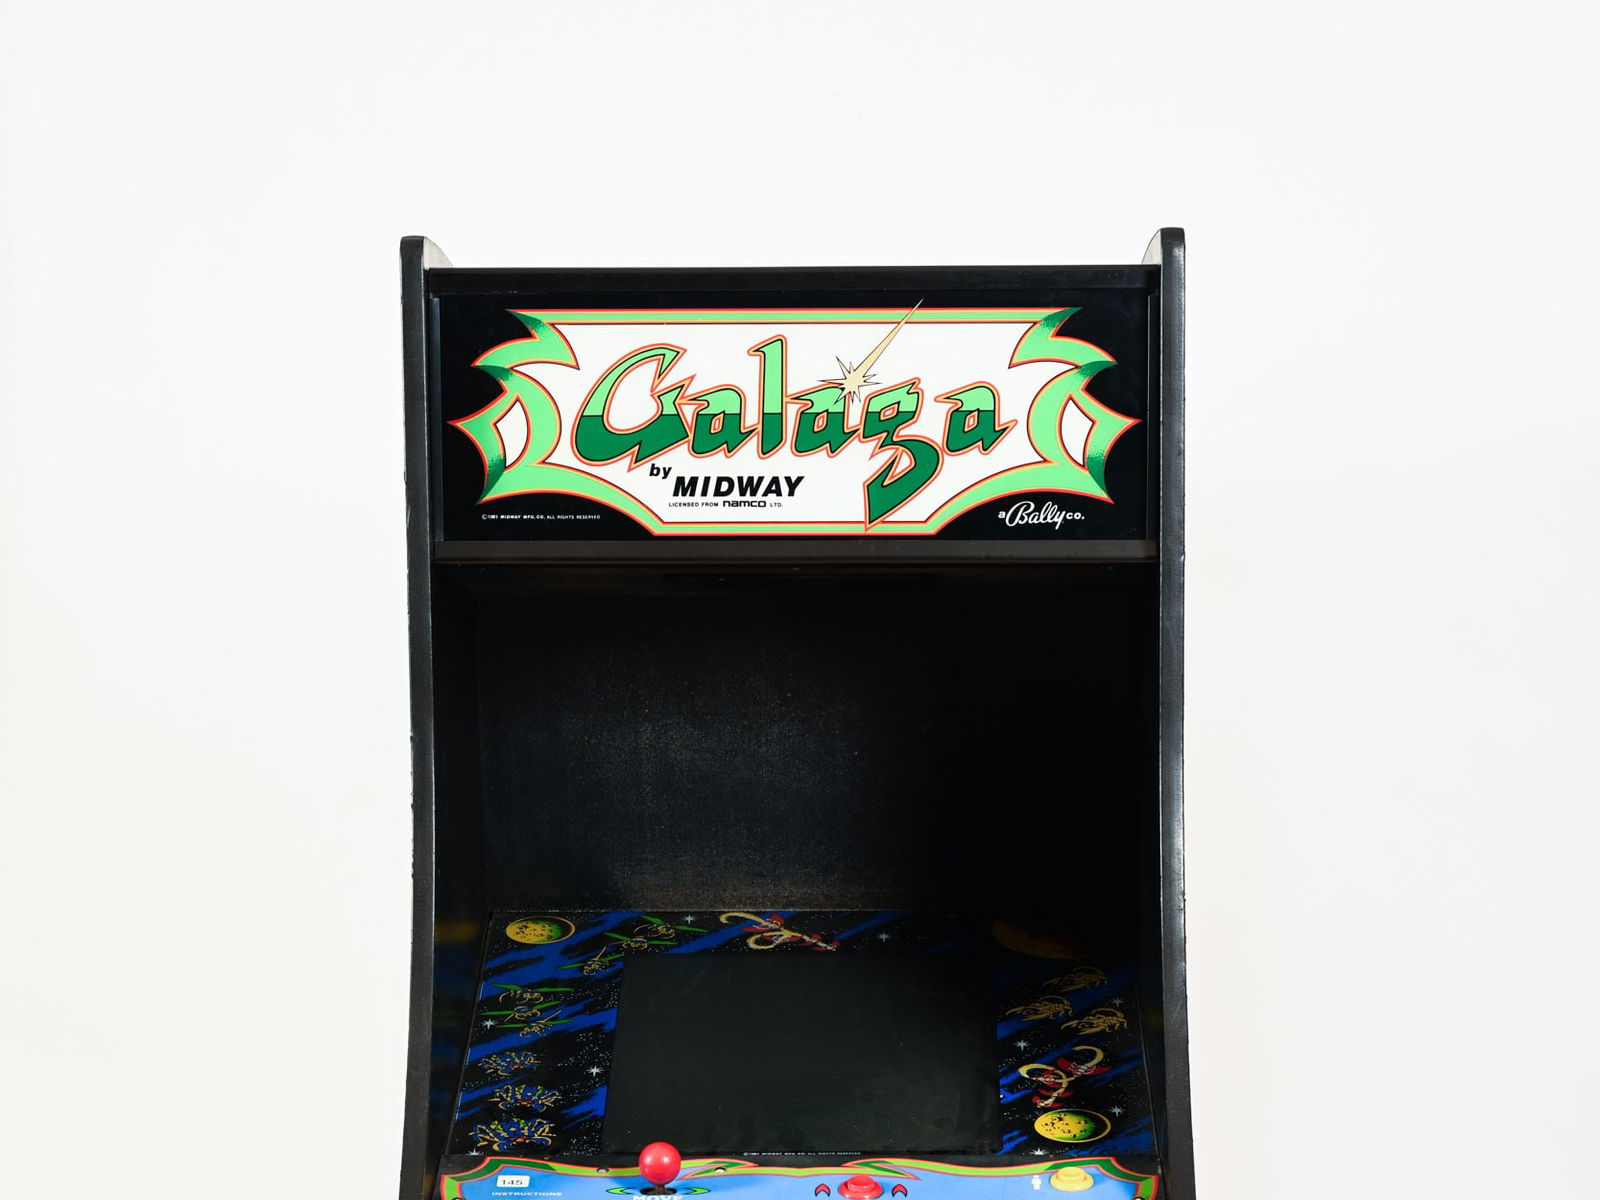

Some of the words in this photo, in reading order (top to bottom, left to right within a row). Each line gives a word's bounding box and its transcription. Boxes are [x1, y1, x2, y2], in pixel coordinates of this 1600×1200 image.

[571, 334, 1018, 531] Galaga
[649, 463, 672, 480] by
[672, 475, 805, 497] MIDWAY
[722, 500, 767, 508] namco
[998, 511, 1006, 519] a
[1005, 500, 1066, 530] Bally
[1065, 512, 1085, 520] co.
